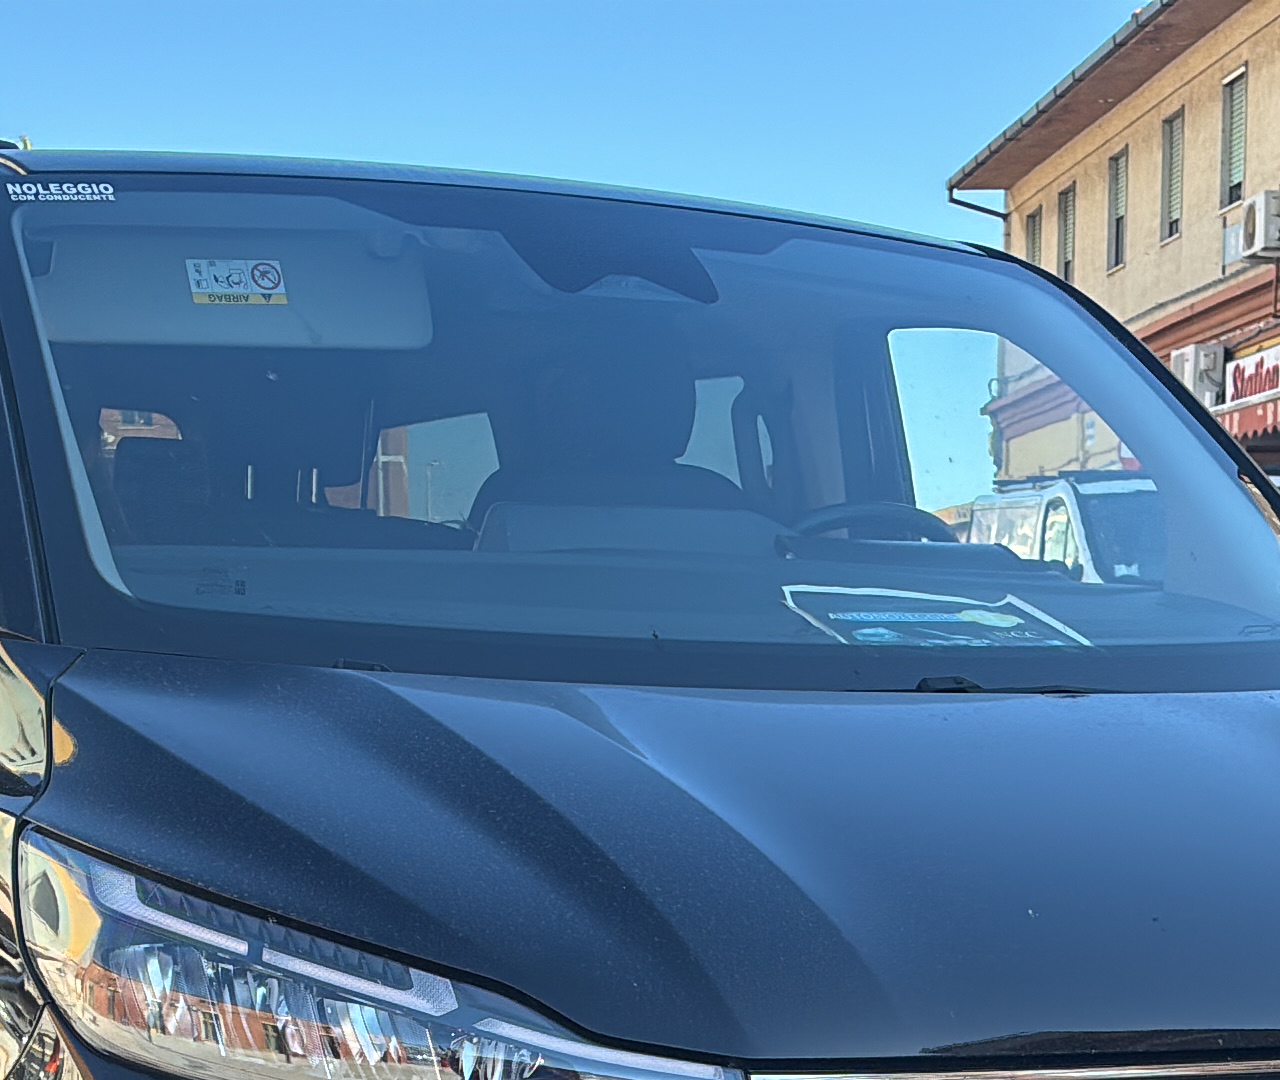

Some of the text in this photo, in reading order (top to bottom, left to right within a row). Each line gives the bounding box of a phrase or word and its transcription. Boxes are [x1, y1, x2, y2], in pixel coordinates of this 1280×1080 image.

[5, 182, 114, 195] NOLEGGIO
[208, 294, 250, 303] AIRBAG
[1230, 354, 1279, 402] Station
